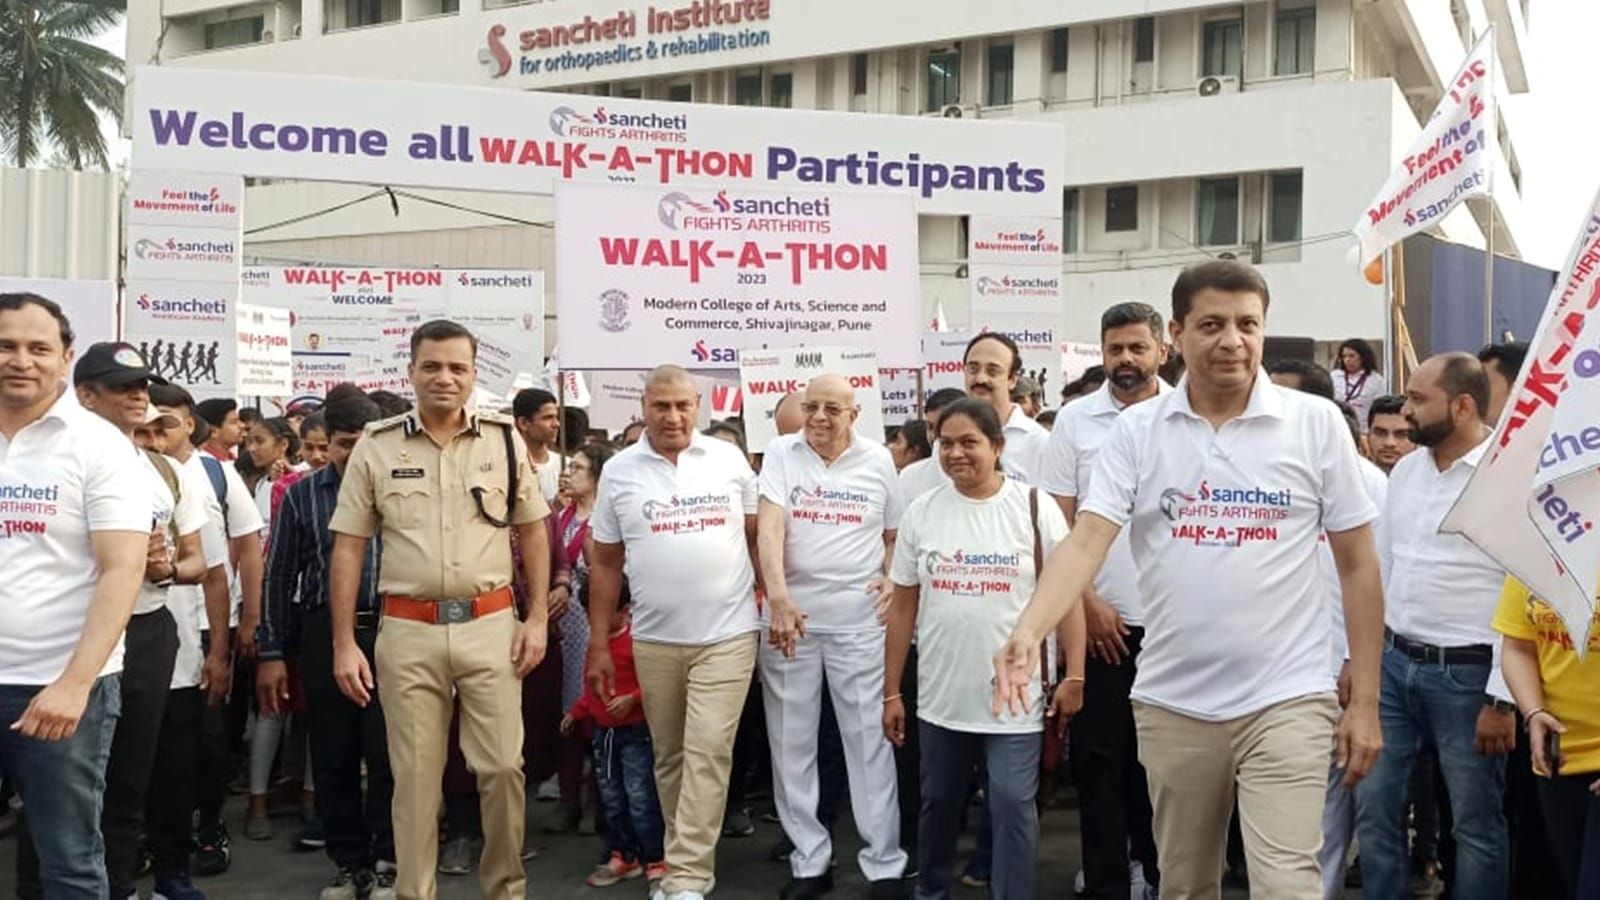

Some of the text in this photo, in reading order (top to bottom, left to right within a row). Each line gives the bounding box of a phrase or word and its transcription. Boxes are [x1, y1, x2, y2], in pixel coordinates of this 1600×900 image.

[520, 0, 771, 50] sancheti institute
[520, 28, 771, 75] for orthopaedics & rehabilitation
[608, 111, 687, 130] sancheti
[569, 125, 687, 142] FIGHTS ARTHRITIS
[149, 109, 1045, 198] Welcome all WALK-A-THON Participants
[1403, 138, 1441, 176] Feel
[163, 189, 209, 201] Feel the
[1368, 149, 1465, 226] Movement
[134, 200, 236, 214] Movement of Life
[733, 196, 830, 216] sancheti
[684, 216, 831, 234] FIGHTS ARTHRITIS
[998, 232, 1036, 241] Feel the
[177, 242, 234, 253] sancheti
[975, 242, 1028, 251] Movement
[1030, 243, 1040, 251] of
[599, 236, 888, 285] WALK-A-THON
[284, 269, 442, 293] WALK-A-THON
[471, 274, 532, 287] sancheti
[737, 273, 767, 285] 2023
[1011, 278, 1058, 288] sancheti
[152, 298, 226, 314] sancheti
[332, 295, 393, 305] WELCOME
[644, 297, 886, 313] Modern College of Arts, Science and
[665, 317, 871, 333] Commerce, Shivajinagar, Pune
[0, 483, 58, 501] ncheti
[681, 492, 730, 506] sancheti
[1211, 486, 1291, 506] sancheti
[650, 517, 726, 534] WALK-A-THON
[792, 509, 863, 526] WALK-A-THON
[964, 552, 1020, 566] sancheti
[931, 579, 1012, 596] WALK-A-THON
